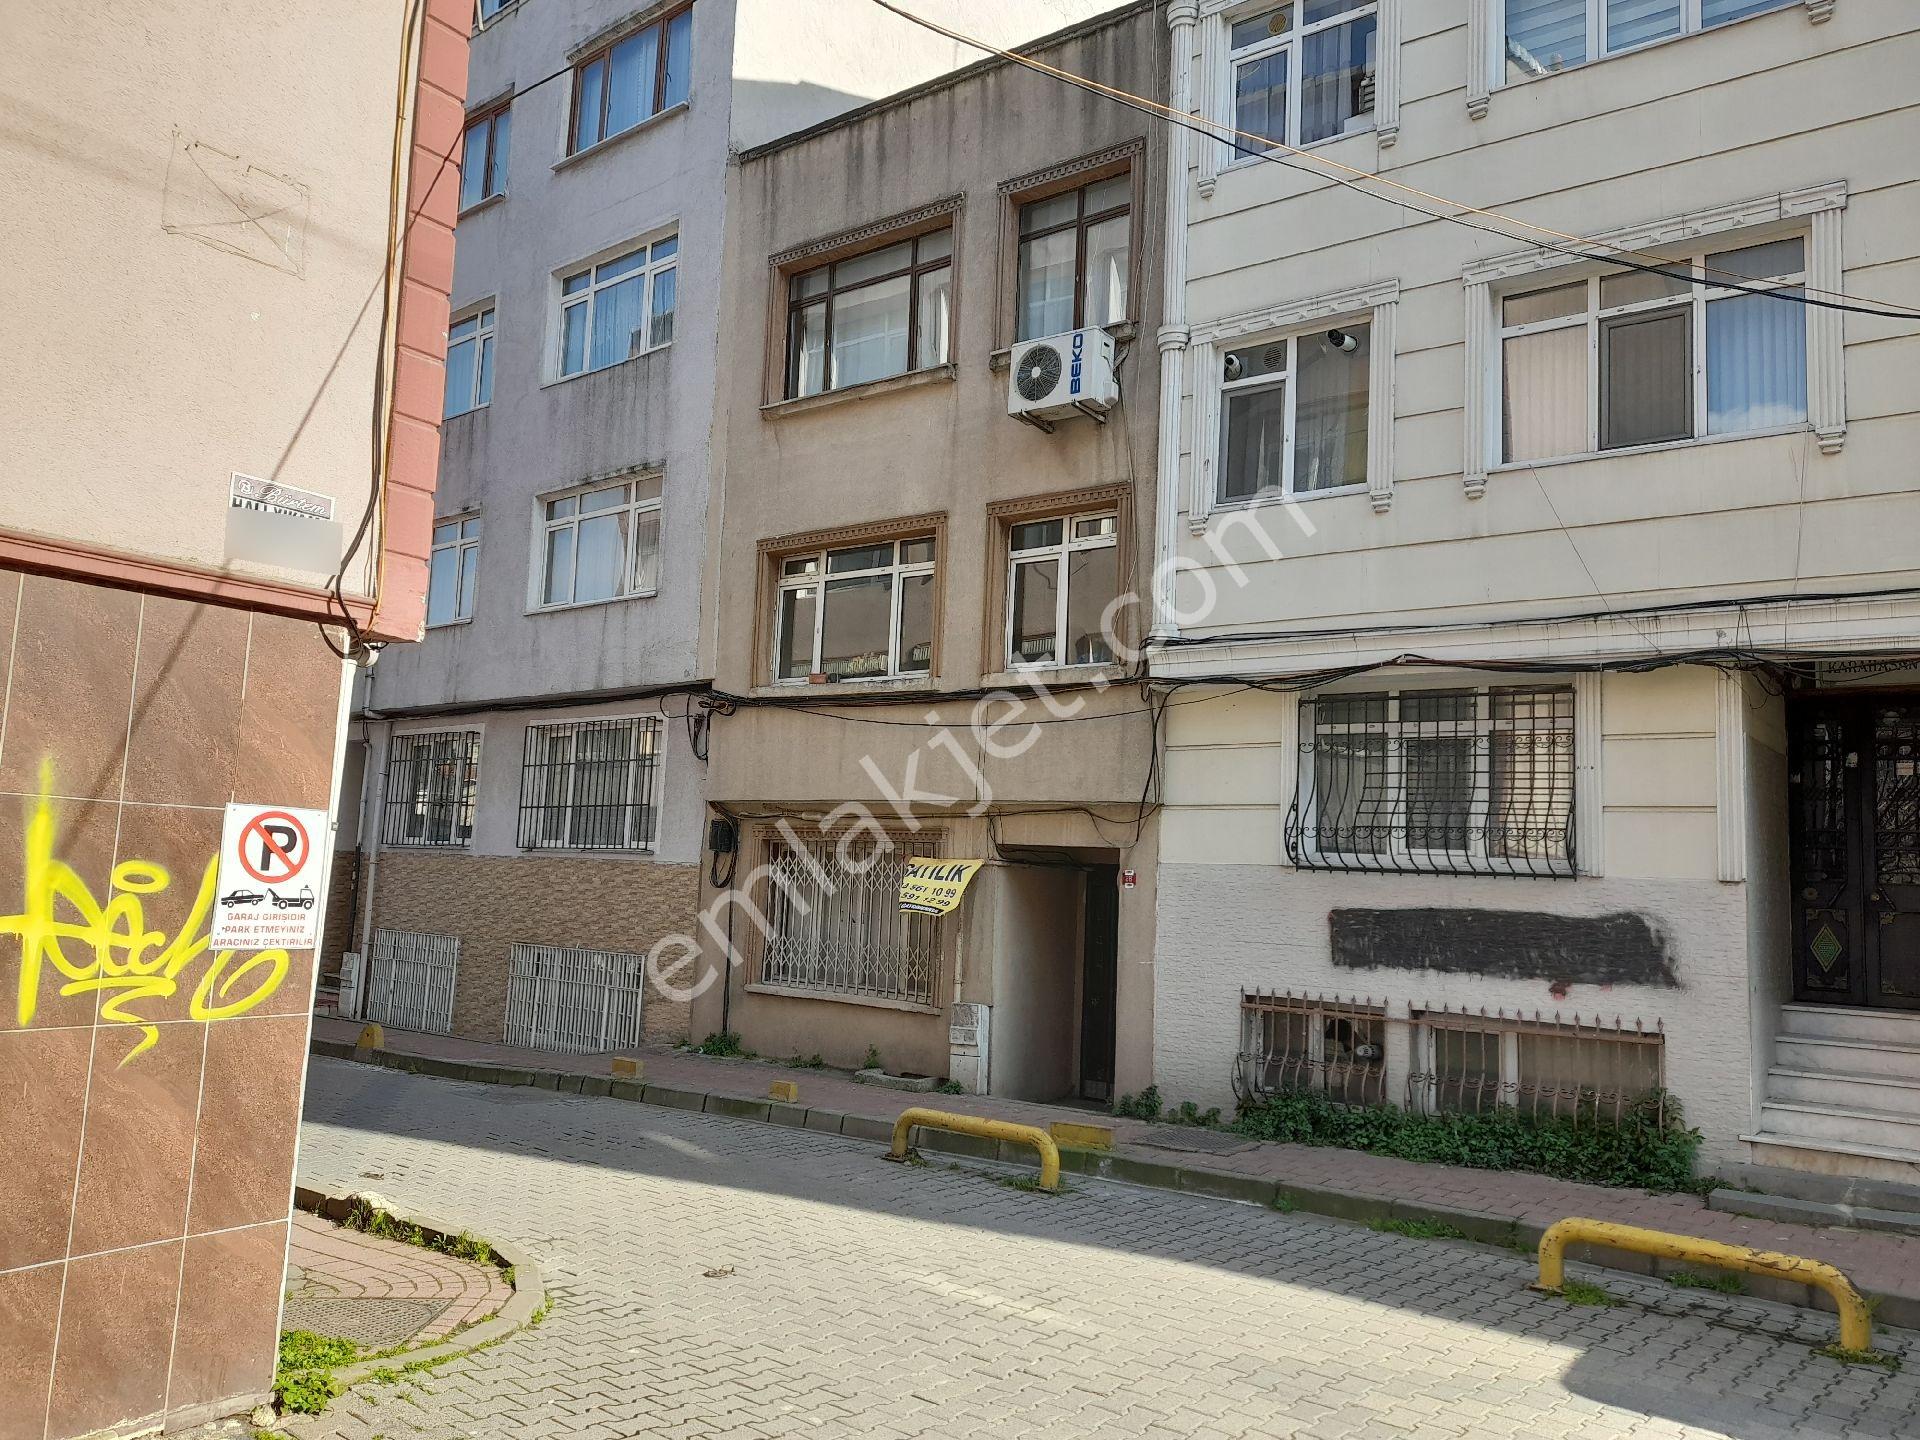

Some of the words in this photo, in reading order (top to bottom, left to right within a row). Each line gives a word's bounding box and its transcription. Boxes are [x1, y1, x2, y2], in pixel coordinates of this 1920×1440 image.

[1070, 333, 1084, 394] BEKO
[227, 912, 260, 921] GARAJ
[224, 925, 250, 934] PARK
